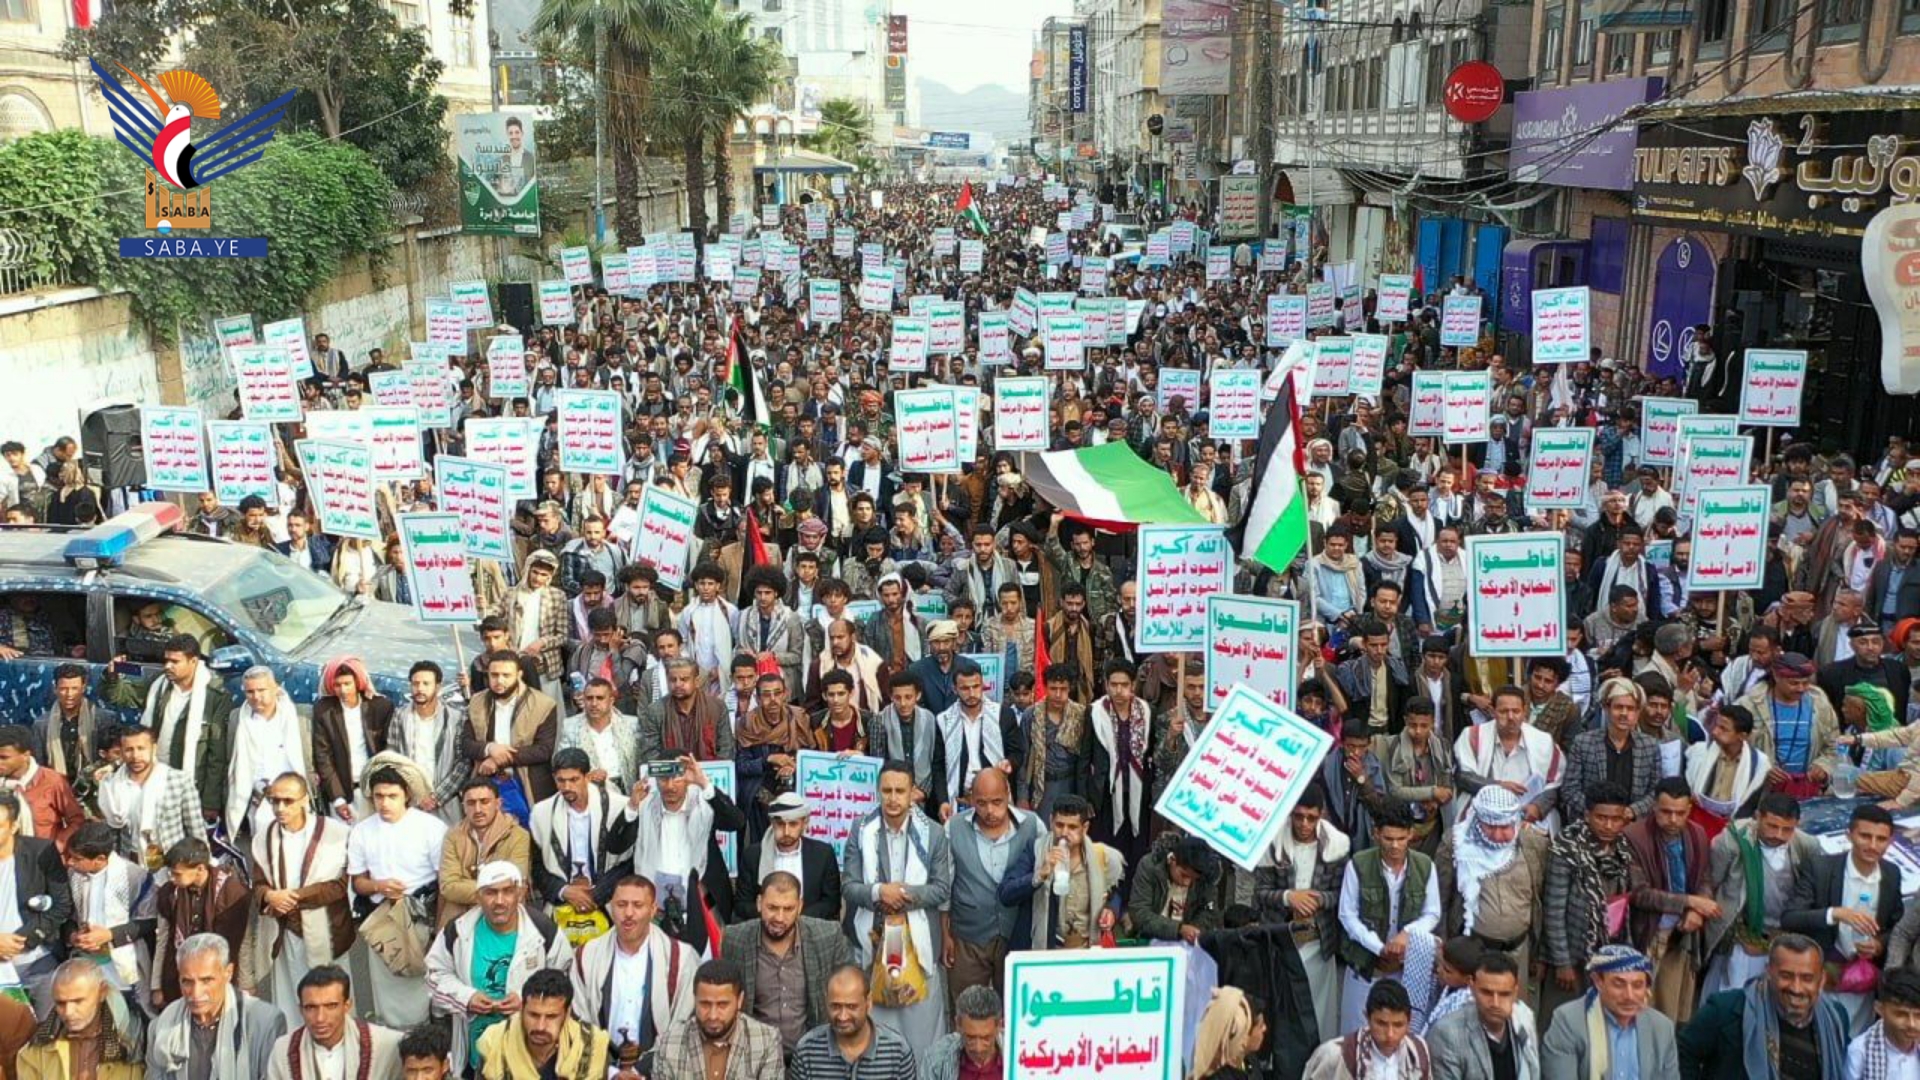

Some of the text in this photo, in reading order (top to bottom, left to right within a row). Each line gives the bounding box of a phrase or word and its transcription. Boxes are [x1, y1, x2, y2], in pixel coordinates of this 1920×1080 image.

[1701, 496, 1766, 518] قاطعوا
[1196, 539, 1224, 554] الله
[1190, 562, 1223, 576] الموت
[1478, 550, 1556, 574] قاطعوا
[1189, 583, 1222, 596] الموت
[1520, 583, 1553, 598] البضائع
[1146, 604, 1192, 618] على اليهود
[1212, 607, 1289, 634] قاطعوا
[1252, 646, 1286, 660] البضائع
[850, 767, 874, 782] الله
[1021, 976, 1161, 1027] قاطعوا
[1018, 1032, 1158, 1076] البضائع الأمريكية
